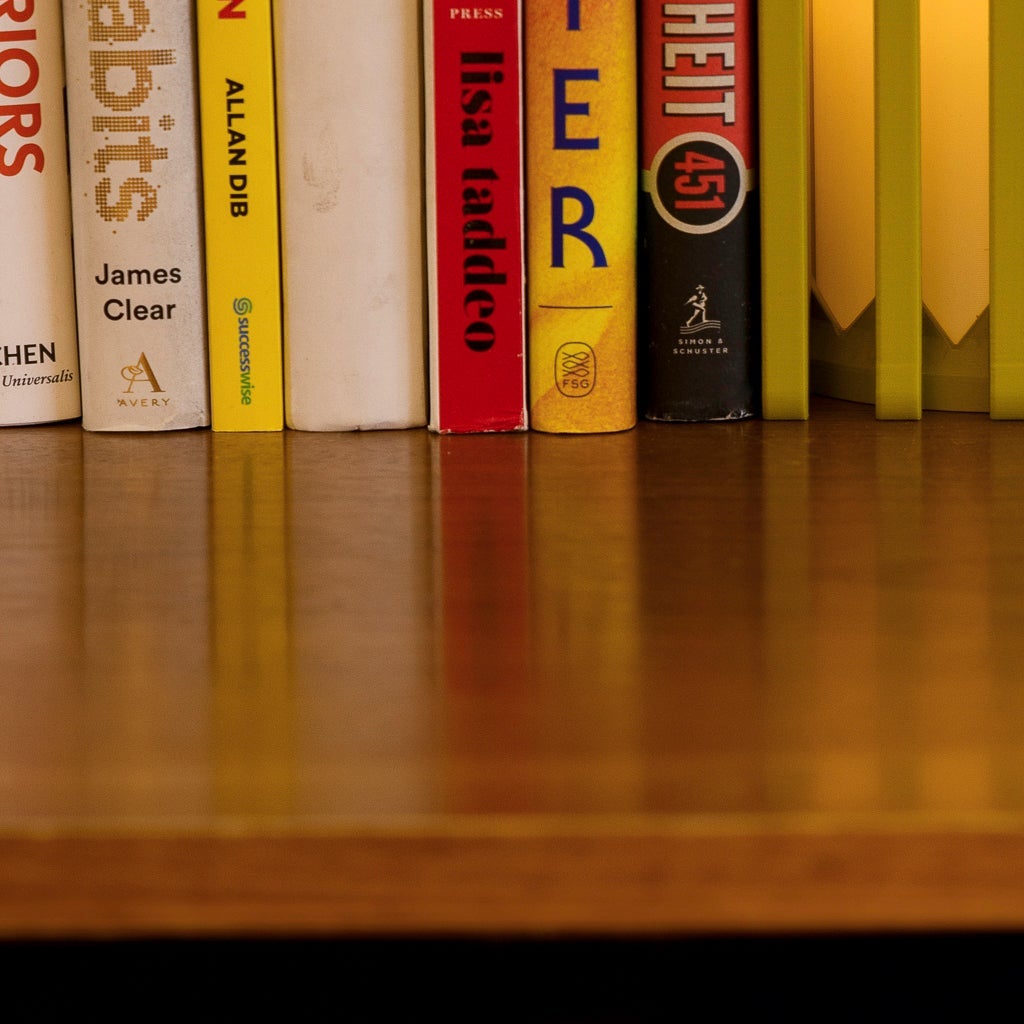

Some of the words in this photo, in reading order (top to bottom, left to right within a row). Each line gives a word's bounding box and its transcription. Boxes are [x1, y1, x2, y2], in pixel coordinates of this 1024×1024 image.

[451, 9, 502, 19] PRESS
[461, 52, 504, 146] lisa
[226, 78, 246, 165] ALLAN
[674, 151, 725, 210] 451
[229, 175, 248, 217] DIB
[462, 168, 507, 352] taddeo
[95, 263, 181, 285] James
[104, 299, 176, 321] Clear
[0, 342, 56, 366] HEN
[238, 317, 251, 405] successwise
[2, 369, 74, 387] Universalis
[563, 379, 589, 389] FSG
[117, 399, 170, 407] AVERY
